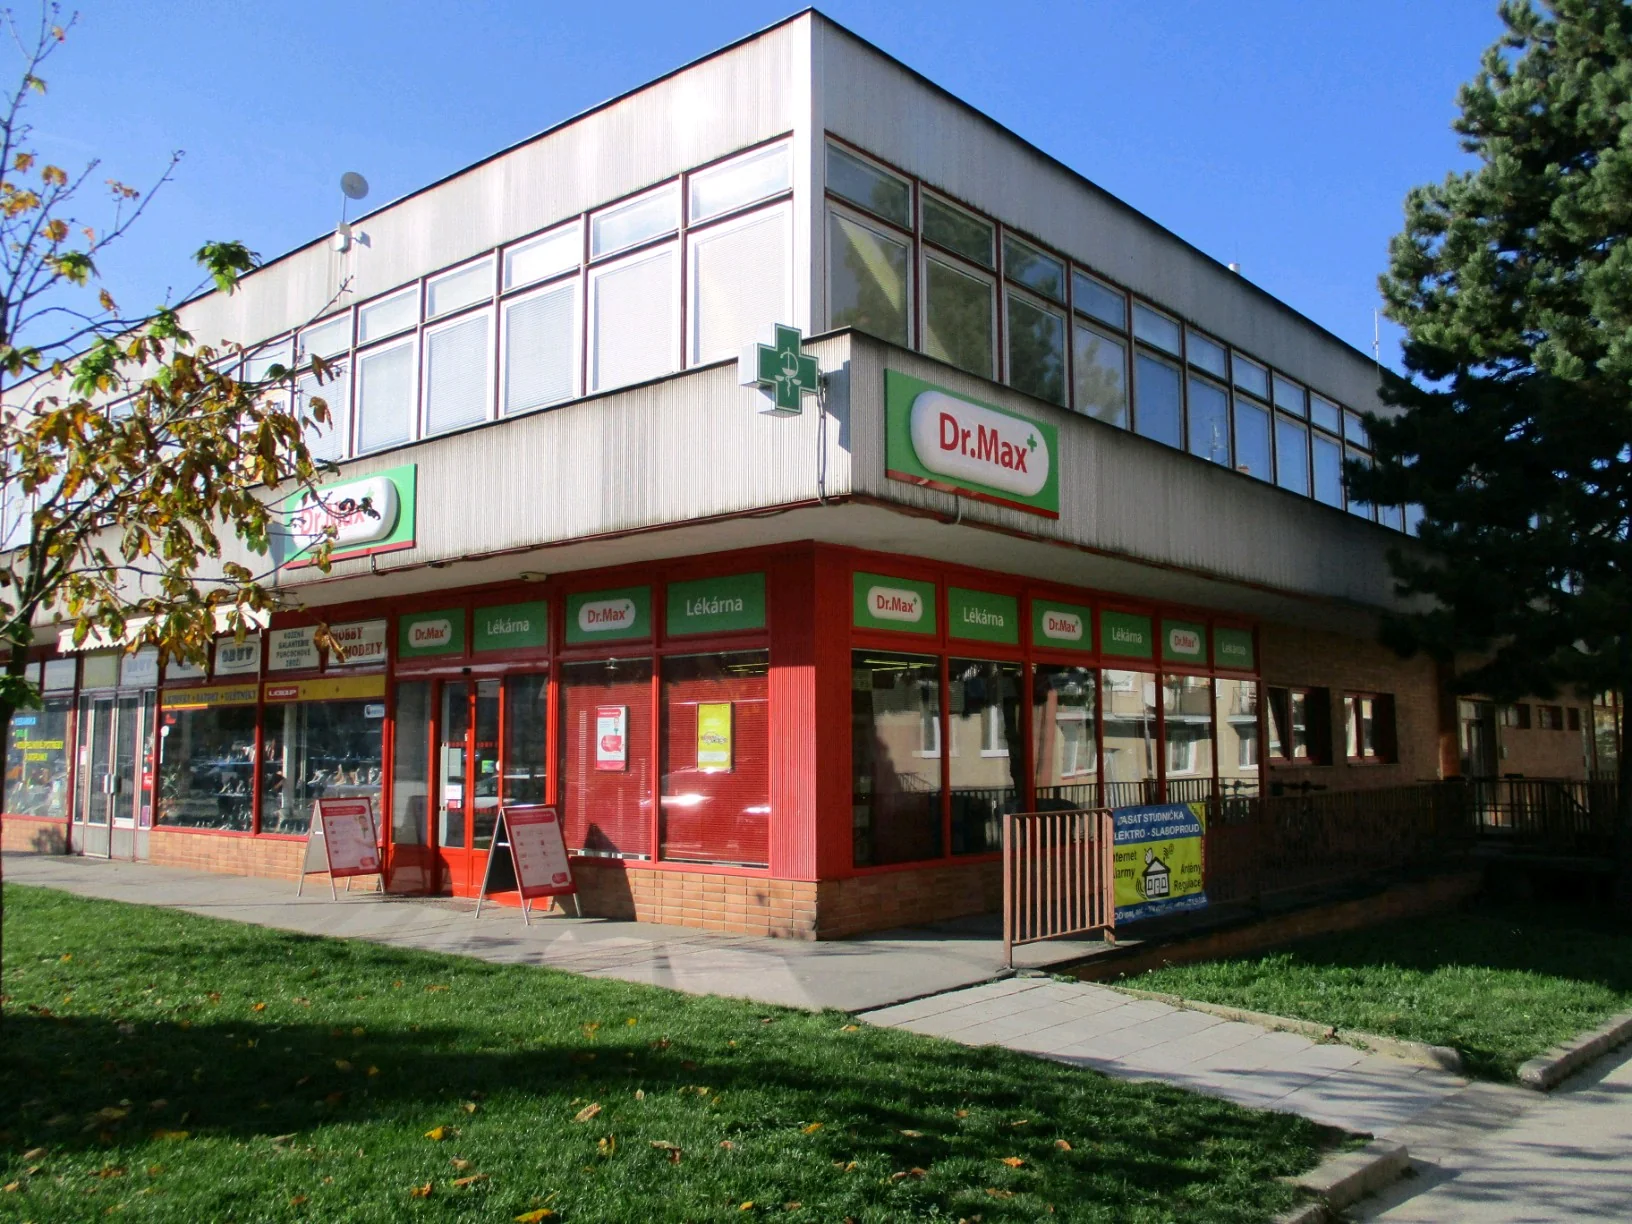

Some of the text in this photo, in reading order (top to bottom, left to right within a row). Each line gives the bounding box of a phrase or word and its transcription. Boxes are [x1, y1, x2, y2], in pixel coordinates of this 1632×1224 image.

[939, 411, 1028, 474] Dr.Max
[300, 501, 365, 535] DrMax
[686, 597, 743, 616] Lékárna
[877, 594, 914, 614] Dr.Max
[587, 607, 627, 624] Dr.Max
[963, 607, 1004, 628] Lékárna
[414, 626, 446, 642] Dr.Max
[487, 618, 530, 636] Lékárna
[1048, 617, 1077, 634] Dr.Max
[1112, 627, 1143, 645] Lékárna
[1173, 633, 1196, 649] Dr.Max
[221, 647, 254, 662] OBUV
[1143, 810, 1185, 823] STUDNIČKA
[1114, 828, 1146, 841] LEKTRO
[1151, 823, 1200, 837] SLABOPROUD
[1113, 851, 1137, 862] ternet
[1114, 867, 1136, 880] larmy
